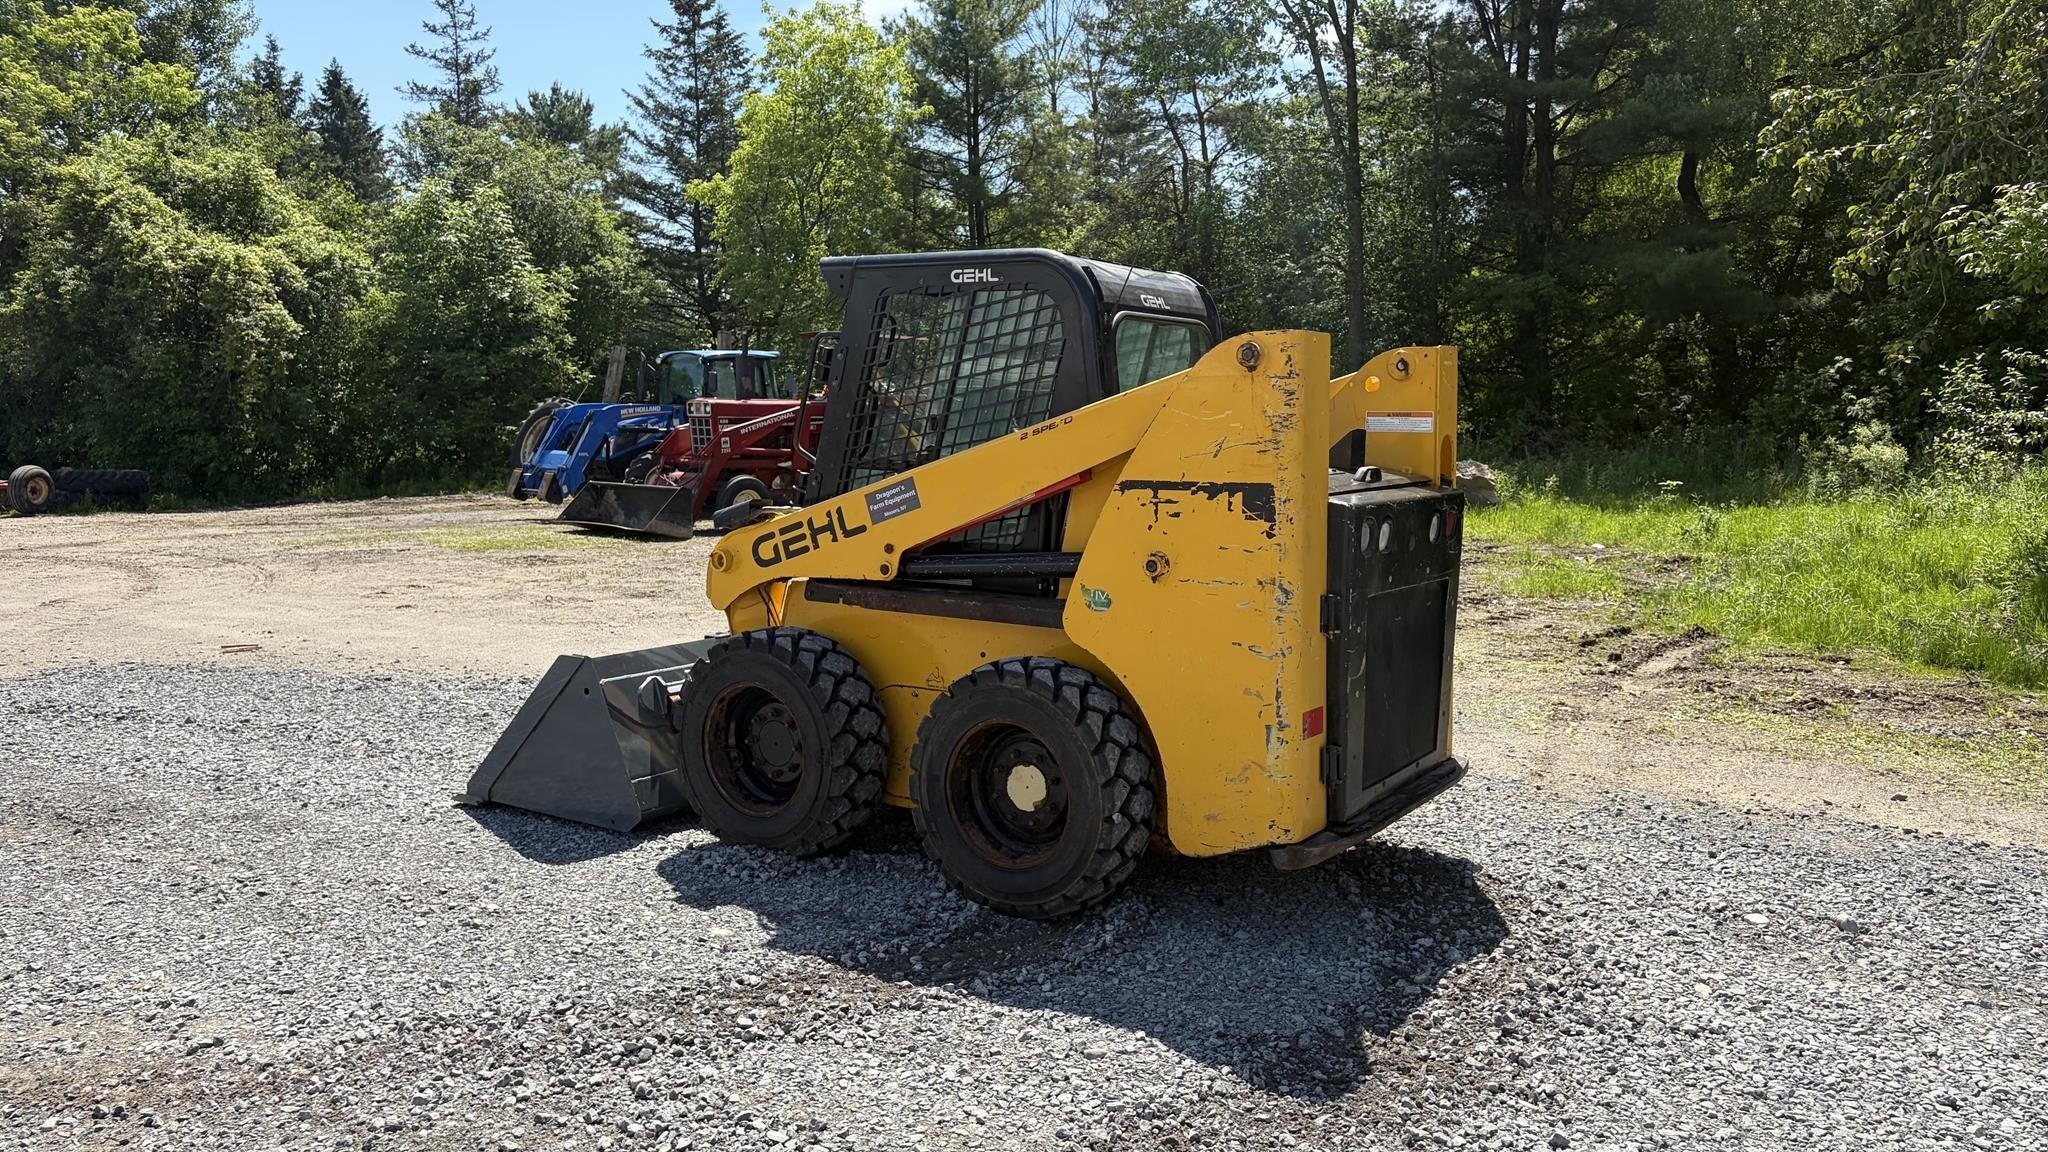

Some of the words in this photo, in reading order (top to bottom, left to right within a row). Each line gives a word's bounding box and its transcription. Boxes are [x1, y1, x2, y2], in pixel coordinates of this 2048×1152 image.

[951, 268, 999, 283] GEHL
[1140, 294, 1171, 310] GEHL
[621, 407, 634, 415] NEW
[635, 405, 661, 413] HOLLAND
[740, 412, 796, 435] INTERNATIONAL
[1020, 432, 1028, 440] 2
[876, 485, 905, 500] Dragoon's
[870, 497, 885, 511] Farm
[884, 490, 916, 506] Equipment
[752, 506, 867, 568] GEHL
